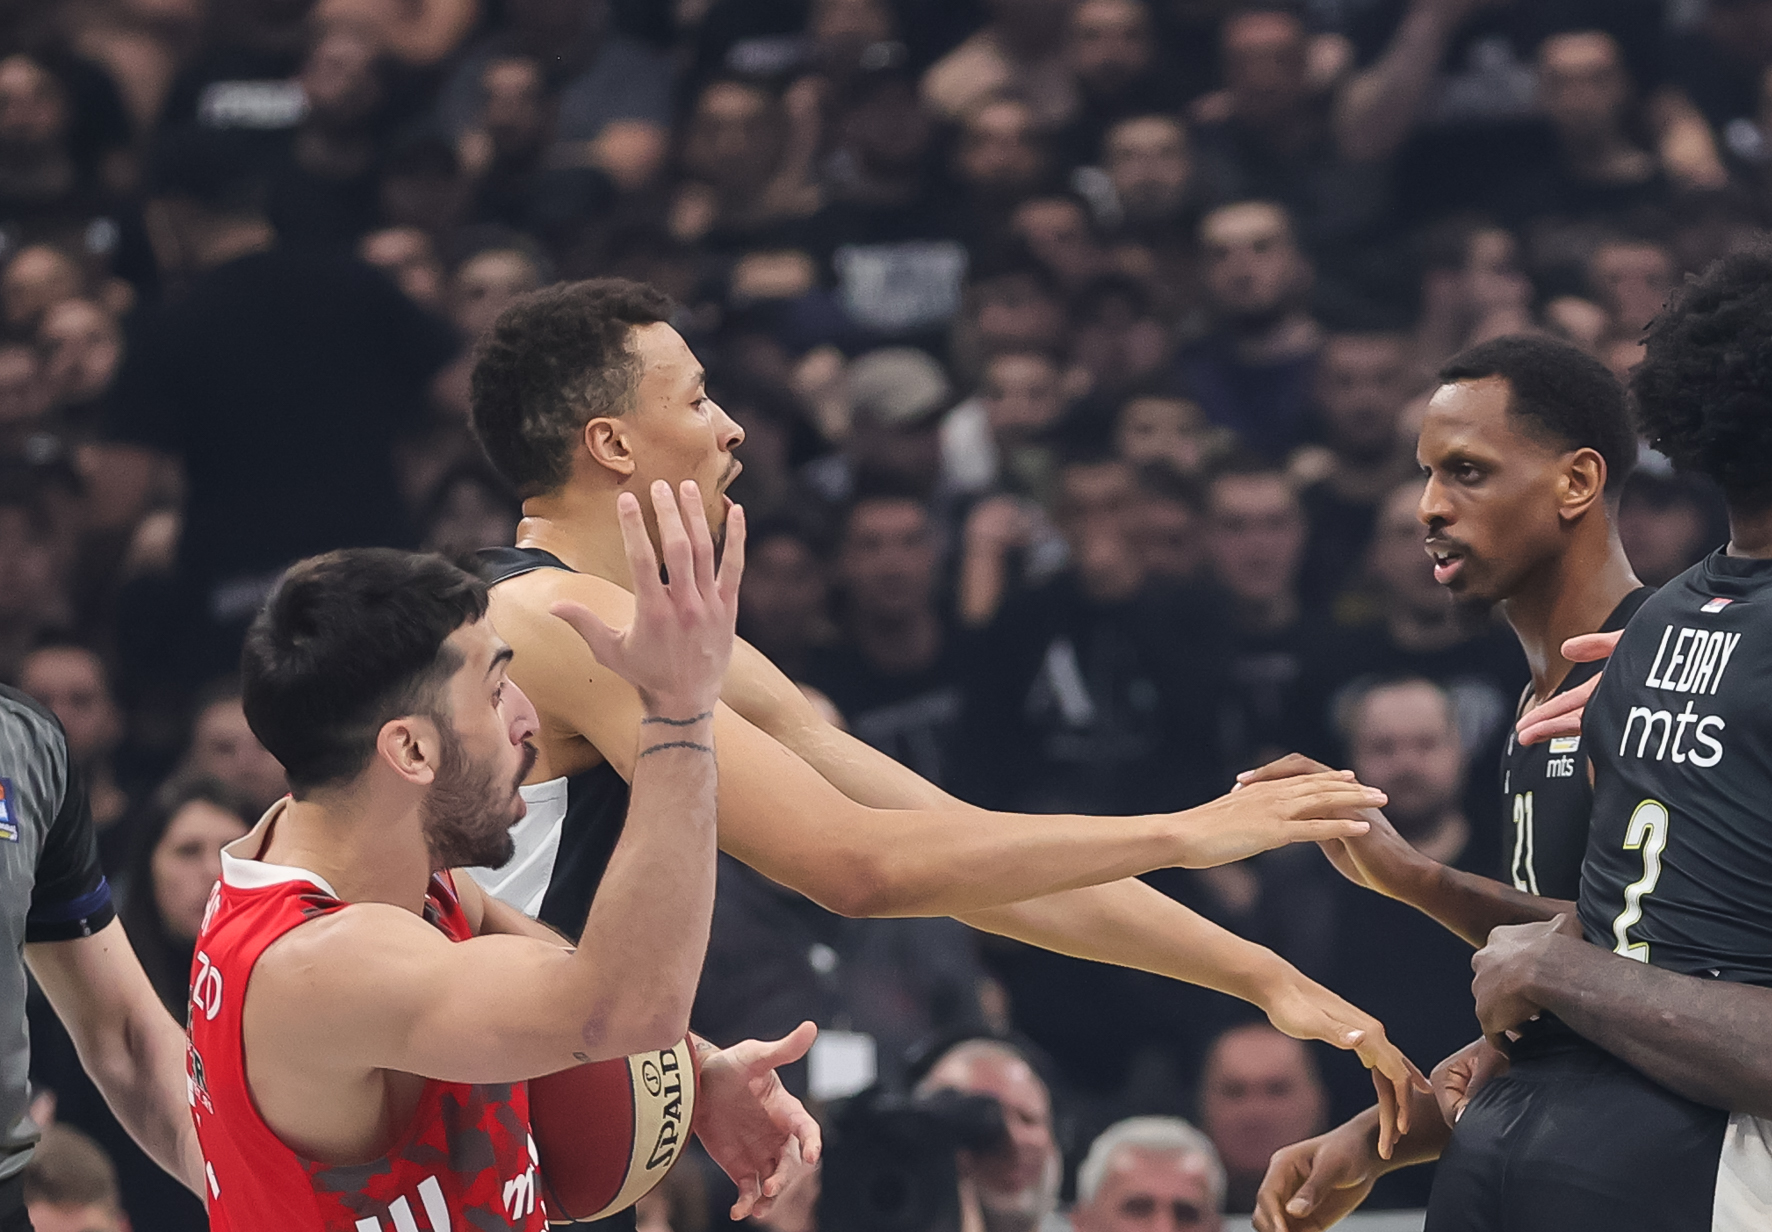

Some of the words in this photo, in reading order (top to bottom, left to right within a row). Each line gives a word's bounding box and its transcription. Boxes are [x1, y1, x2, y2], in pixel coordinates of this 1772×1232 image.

[1645, 624, 1742, 695] LEDAY
[1546, 754, 1575, 778] mts
[1618, 700, 1727, 768] mts
[1511, 790, 1541, 897] 21
[1612, 798, 1669, 964] 2
